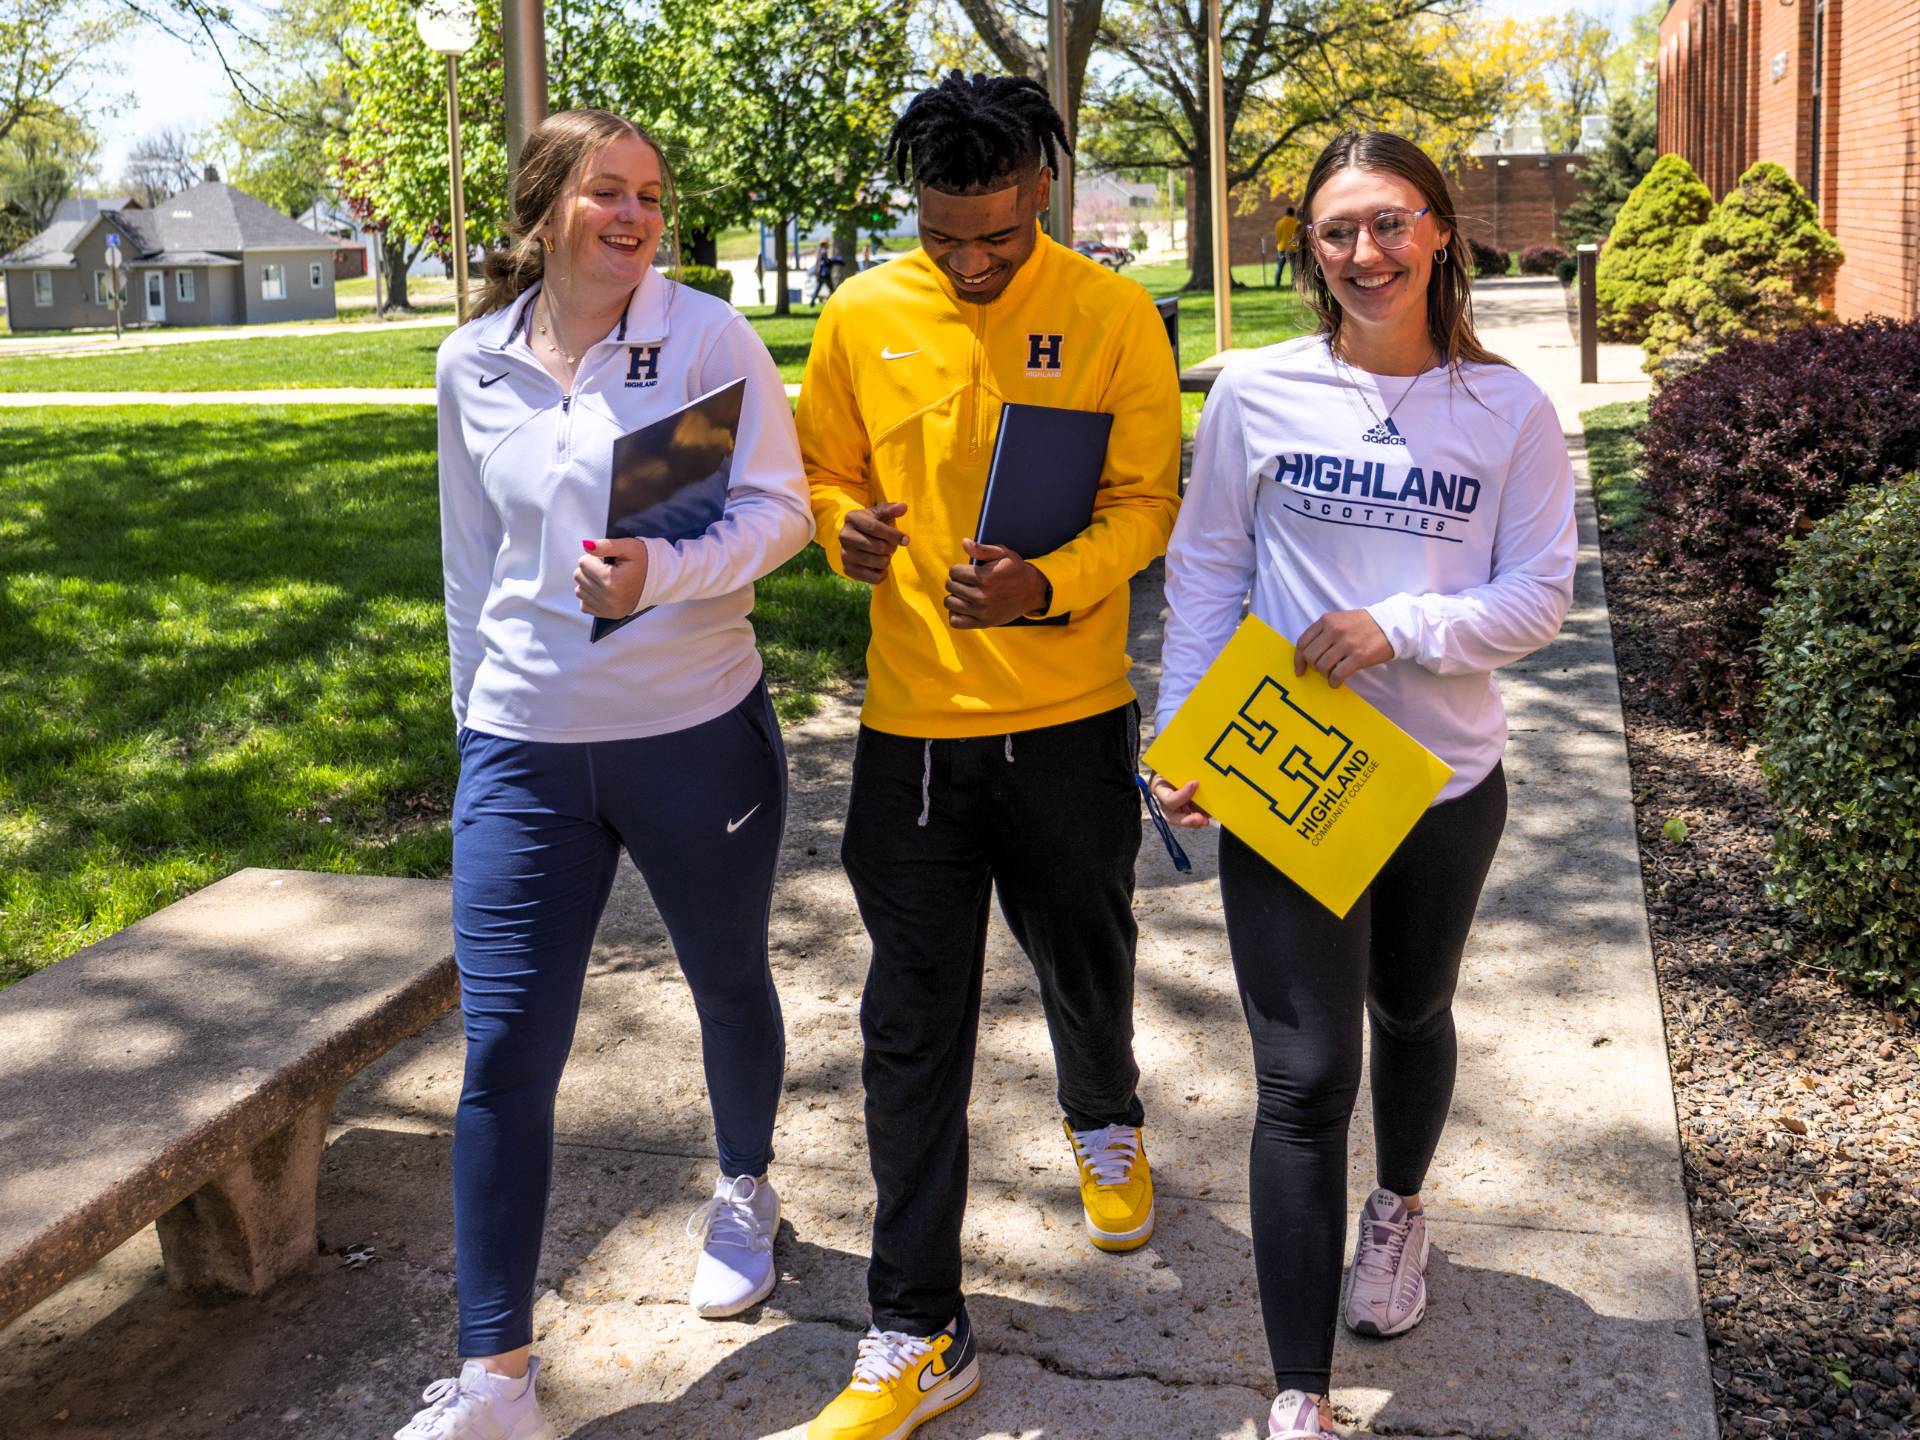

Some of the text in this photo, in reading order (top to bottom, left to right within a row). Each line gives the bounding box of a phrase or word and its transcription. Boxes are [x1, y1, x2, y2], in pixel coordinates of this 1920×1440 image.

[626, 346, 661, 380] H
[1026, 333, 1063, 369] H
[624, 380, 658, 388] HIGHLAND
[1275, 453, 1481, 514] HIGHLAND
[1303, 499, 1446, 532] SCOTTIES
[1204, 675, 1353, 825] H
[1296, 749, 1369, 840] HIGHLAND
[1311, 760, 1379, 847] COMMUNITY COLLEGE
